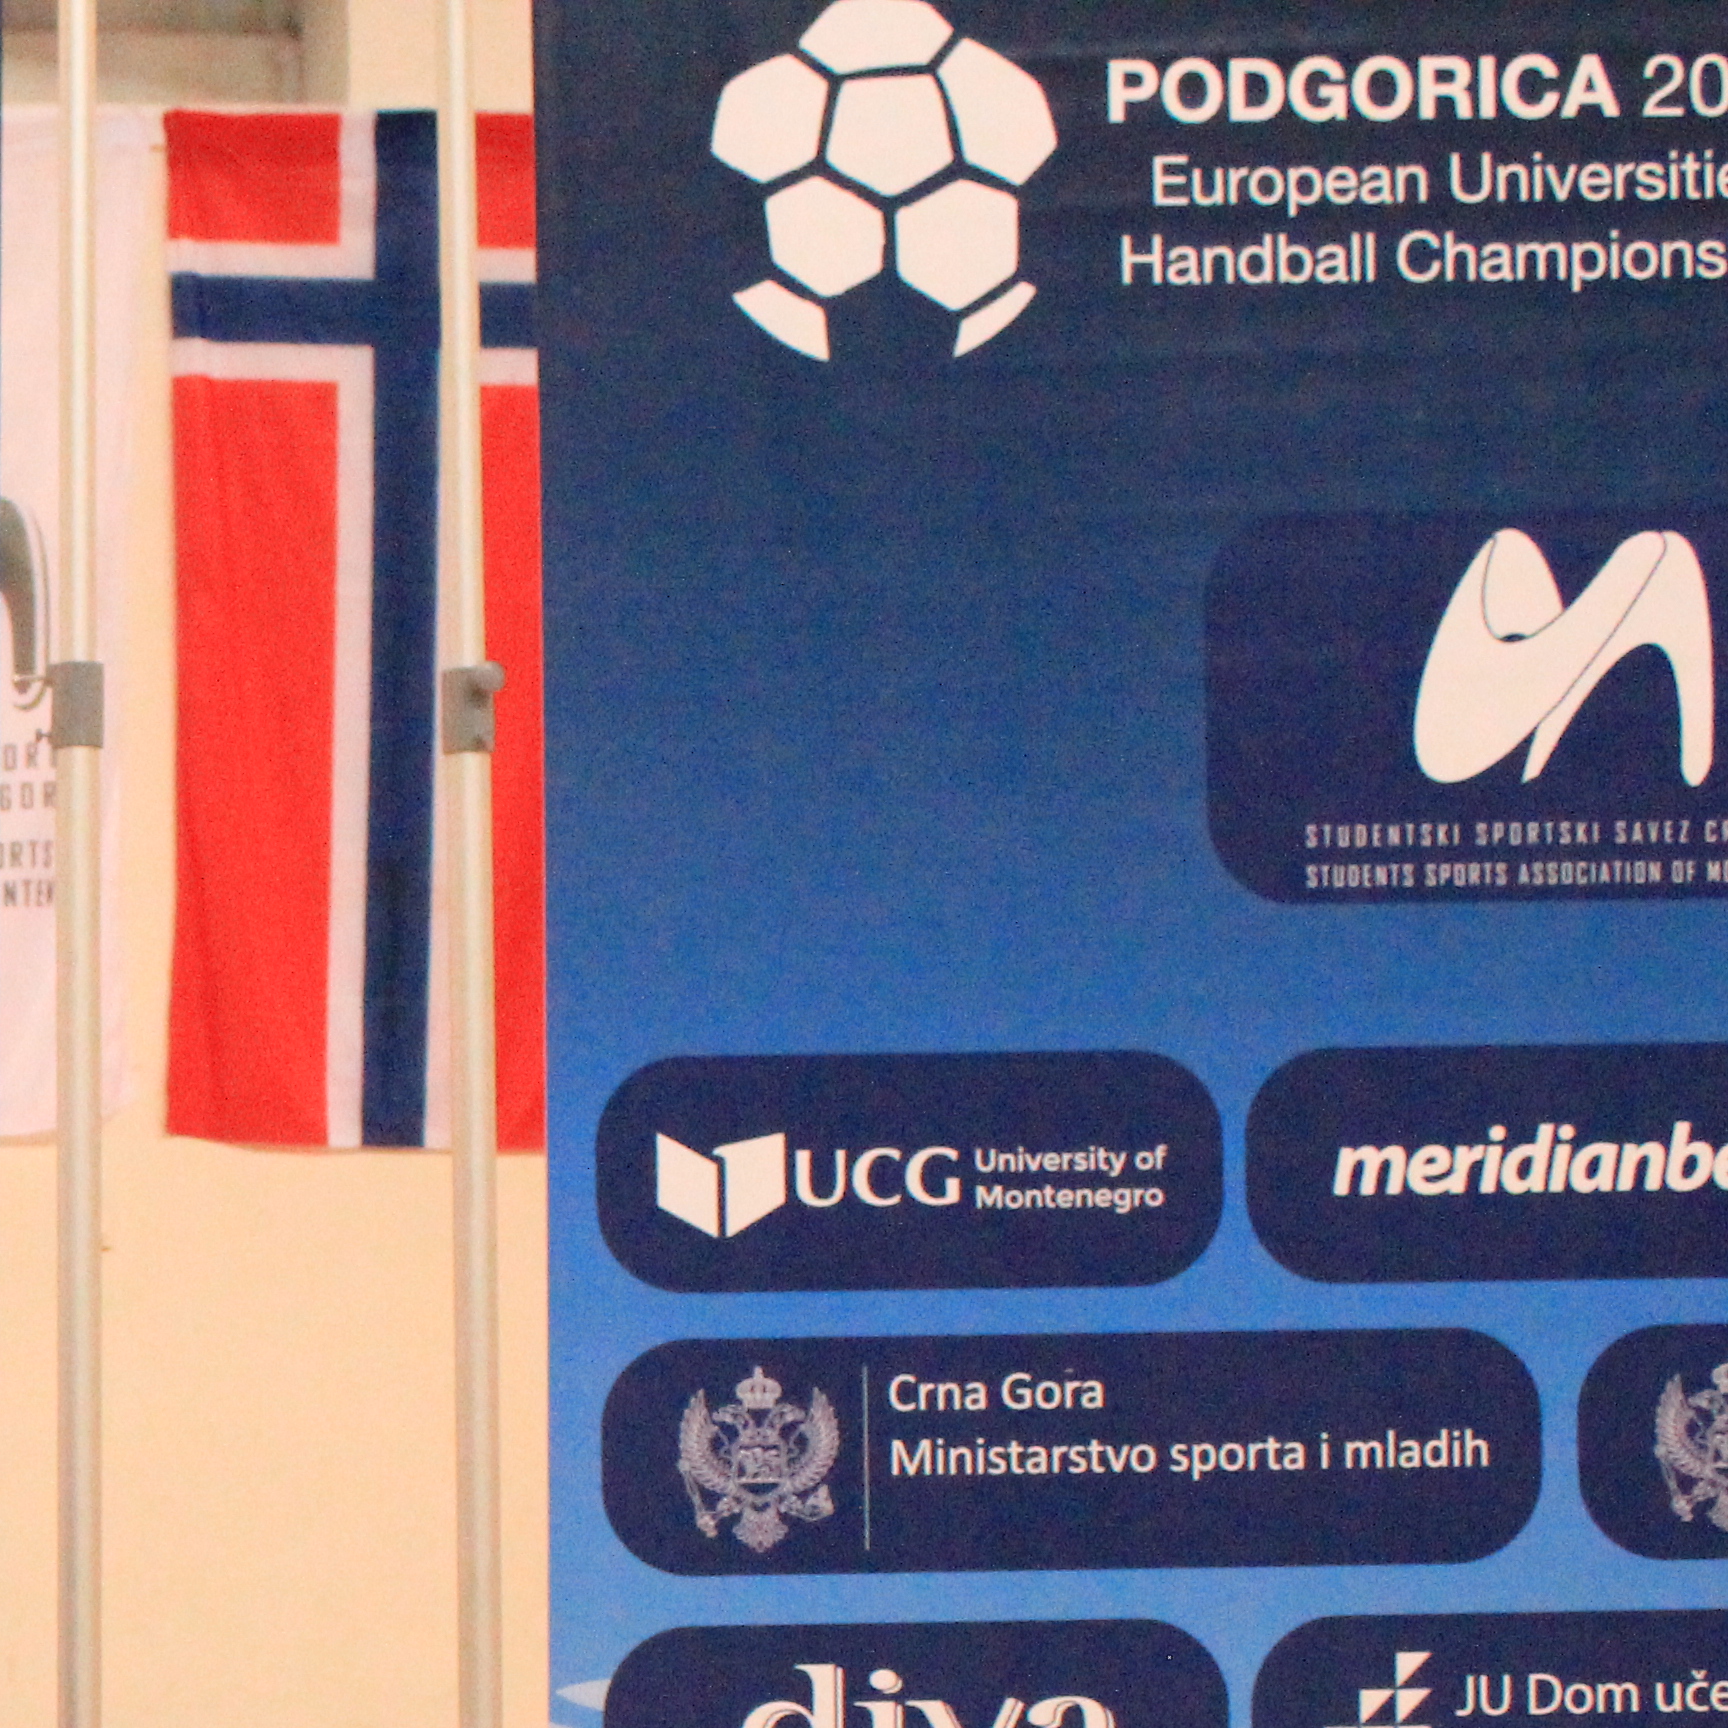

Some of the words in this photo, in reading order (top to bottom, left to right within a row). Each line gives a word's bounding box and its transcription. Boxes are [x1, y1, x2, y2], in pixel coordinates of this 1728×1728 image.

[1107, 54, 1621, 124] PODGORICA
[1152, 154, 1429, 218] European
[1121, 232, 1377, 286] Handball
[1397, 230, 1728, 293] Champions
[1305, 823, 1461, 850] STUDENTSKI
[1475, 821, 1601, 848] SPORTSKI
[1615, 820, 1691, 845] SAVEZ
[1306, 863, 1415, 889] STUDENTS
[1425, 862, 1509, 888] SPORTS
[1519, 860, 1662, 887] ASSOCIATION
[1671, 859, 1697, 884] OF
[794, 1146, 962, 1209] UCG
[974, 1146, 1128, 1178] University
[1135, 1144, 1168, 1172] of
[975, 1183, 1165, 1215] Montenegro
[889, 1374, 990, 1413] Crna
[1001, 1373, 1106, 1411] Gora
[889, 1437, 1159, 1478] Ministarstvo
[1170, 1436, 1307, 1483] sporta
[1320, 1432, 1332, 1470] i
[1344, 1429, 1491, 1470] mladih
[1455, 1675, 1514, 1719] JU
[1527, 1673, 1641, 1717] Dom
